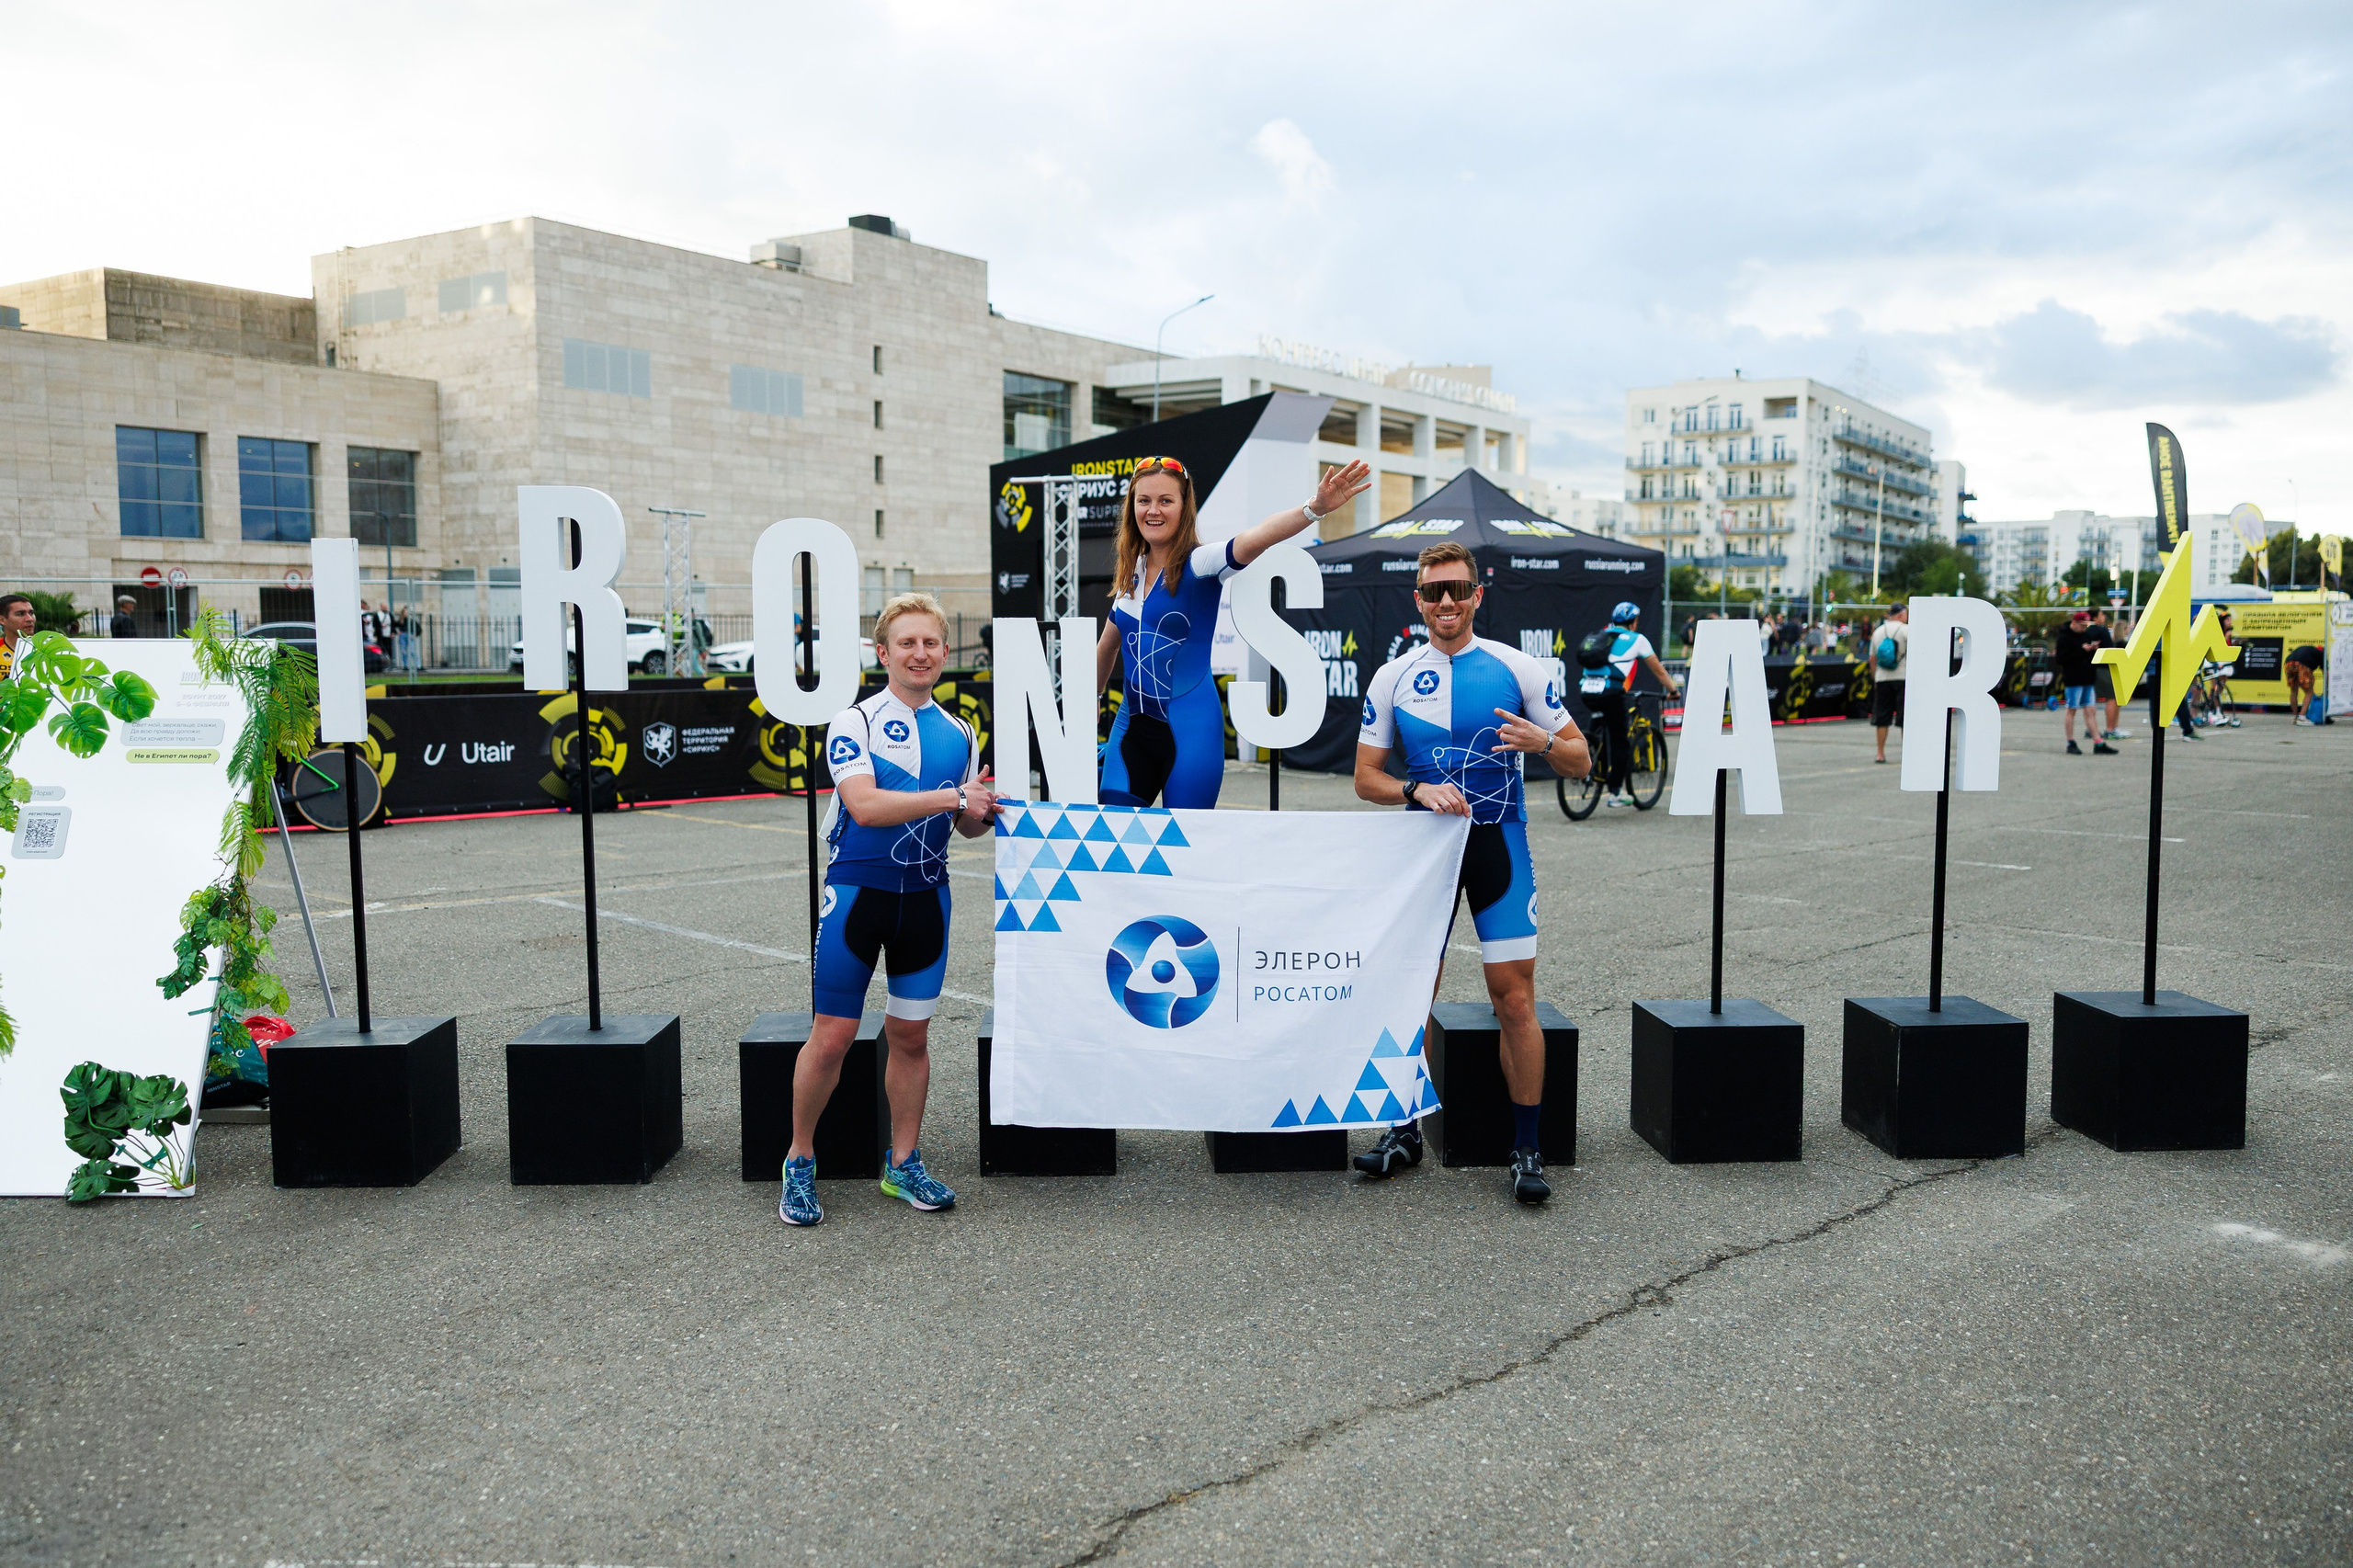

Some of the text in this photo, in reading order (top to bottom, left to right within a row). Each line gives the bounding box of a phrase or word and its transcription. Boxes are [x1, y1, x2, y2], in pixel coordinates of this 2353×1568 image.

[1510, 555, 1560, 569] iron-star.com
[1584, 558, 1645, 574] russiarunning.com
[1520, 630, 1552, 657] IRON
[1324, 661, 1358, 697] TAR
[681, 726, 735, 736] ФЕДЕРАЛЬНАЯ
[682, 735, 729, 744] ТЕРРИТОРИЯ
[461, 740, 515, 764] Utair
[833, 762, 867, 776] ROSATOM
[1255, 950, 1360, 971] ЭЛЕРОН
[1254, 984, 1352, 1002] РОСАТОМ
